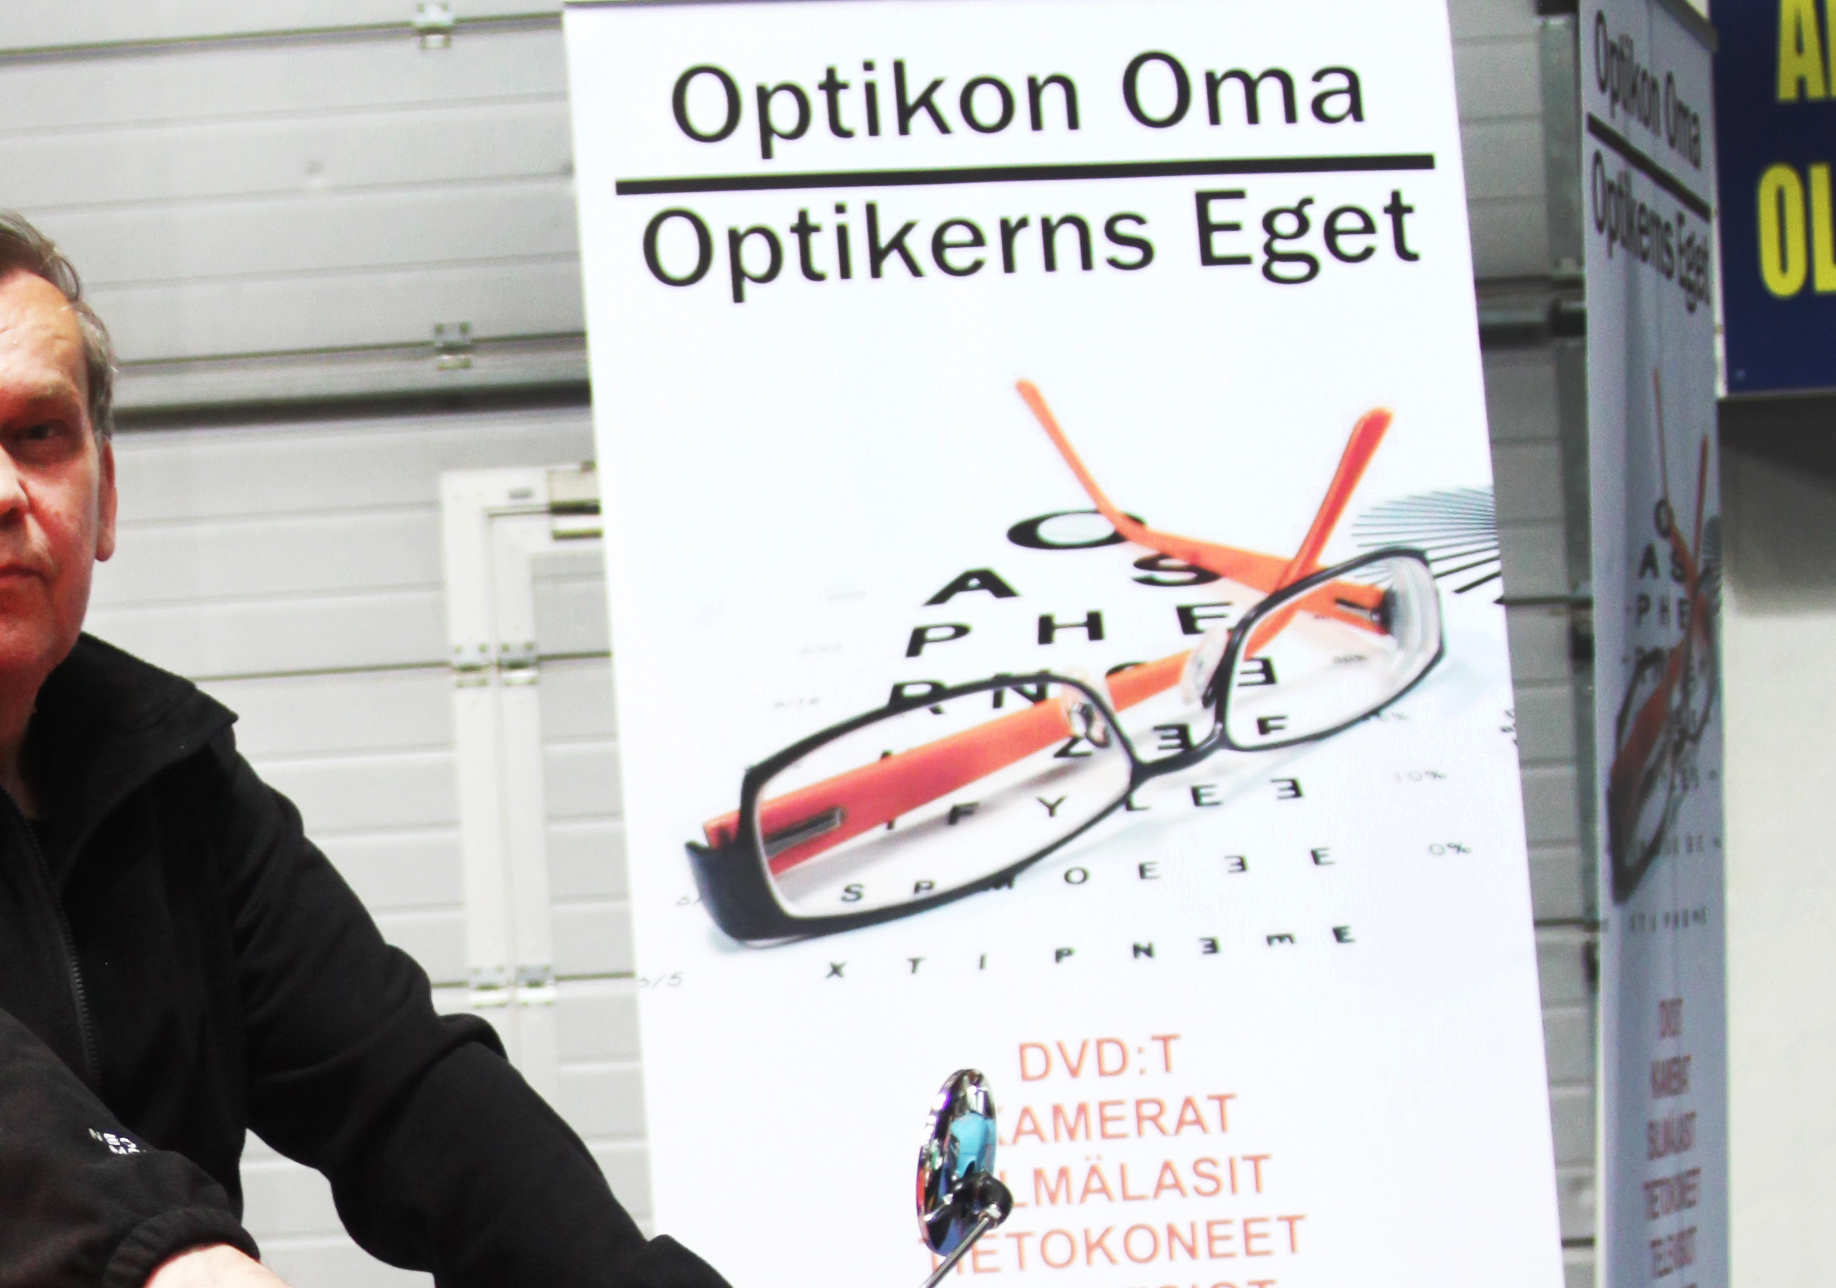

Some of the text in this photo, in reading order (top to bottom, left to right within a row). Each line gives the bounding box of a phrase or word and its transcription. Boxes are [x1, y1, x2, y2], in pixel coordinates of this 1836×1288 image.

[1594, 9, 1702, 172] Optikon Oma
[1778, 0, 1836, 101] A
[672, 50, 1366, 160] Optikon Oma
[641, 188, 1421, 305] Optikerns Eget
[1037, 609, 1105, 645] H
[1018, 1034, 1181, 1083] DVD:T
